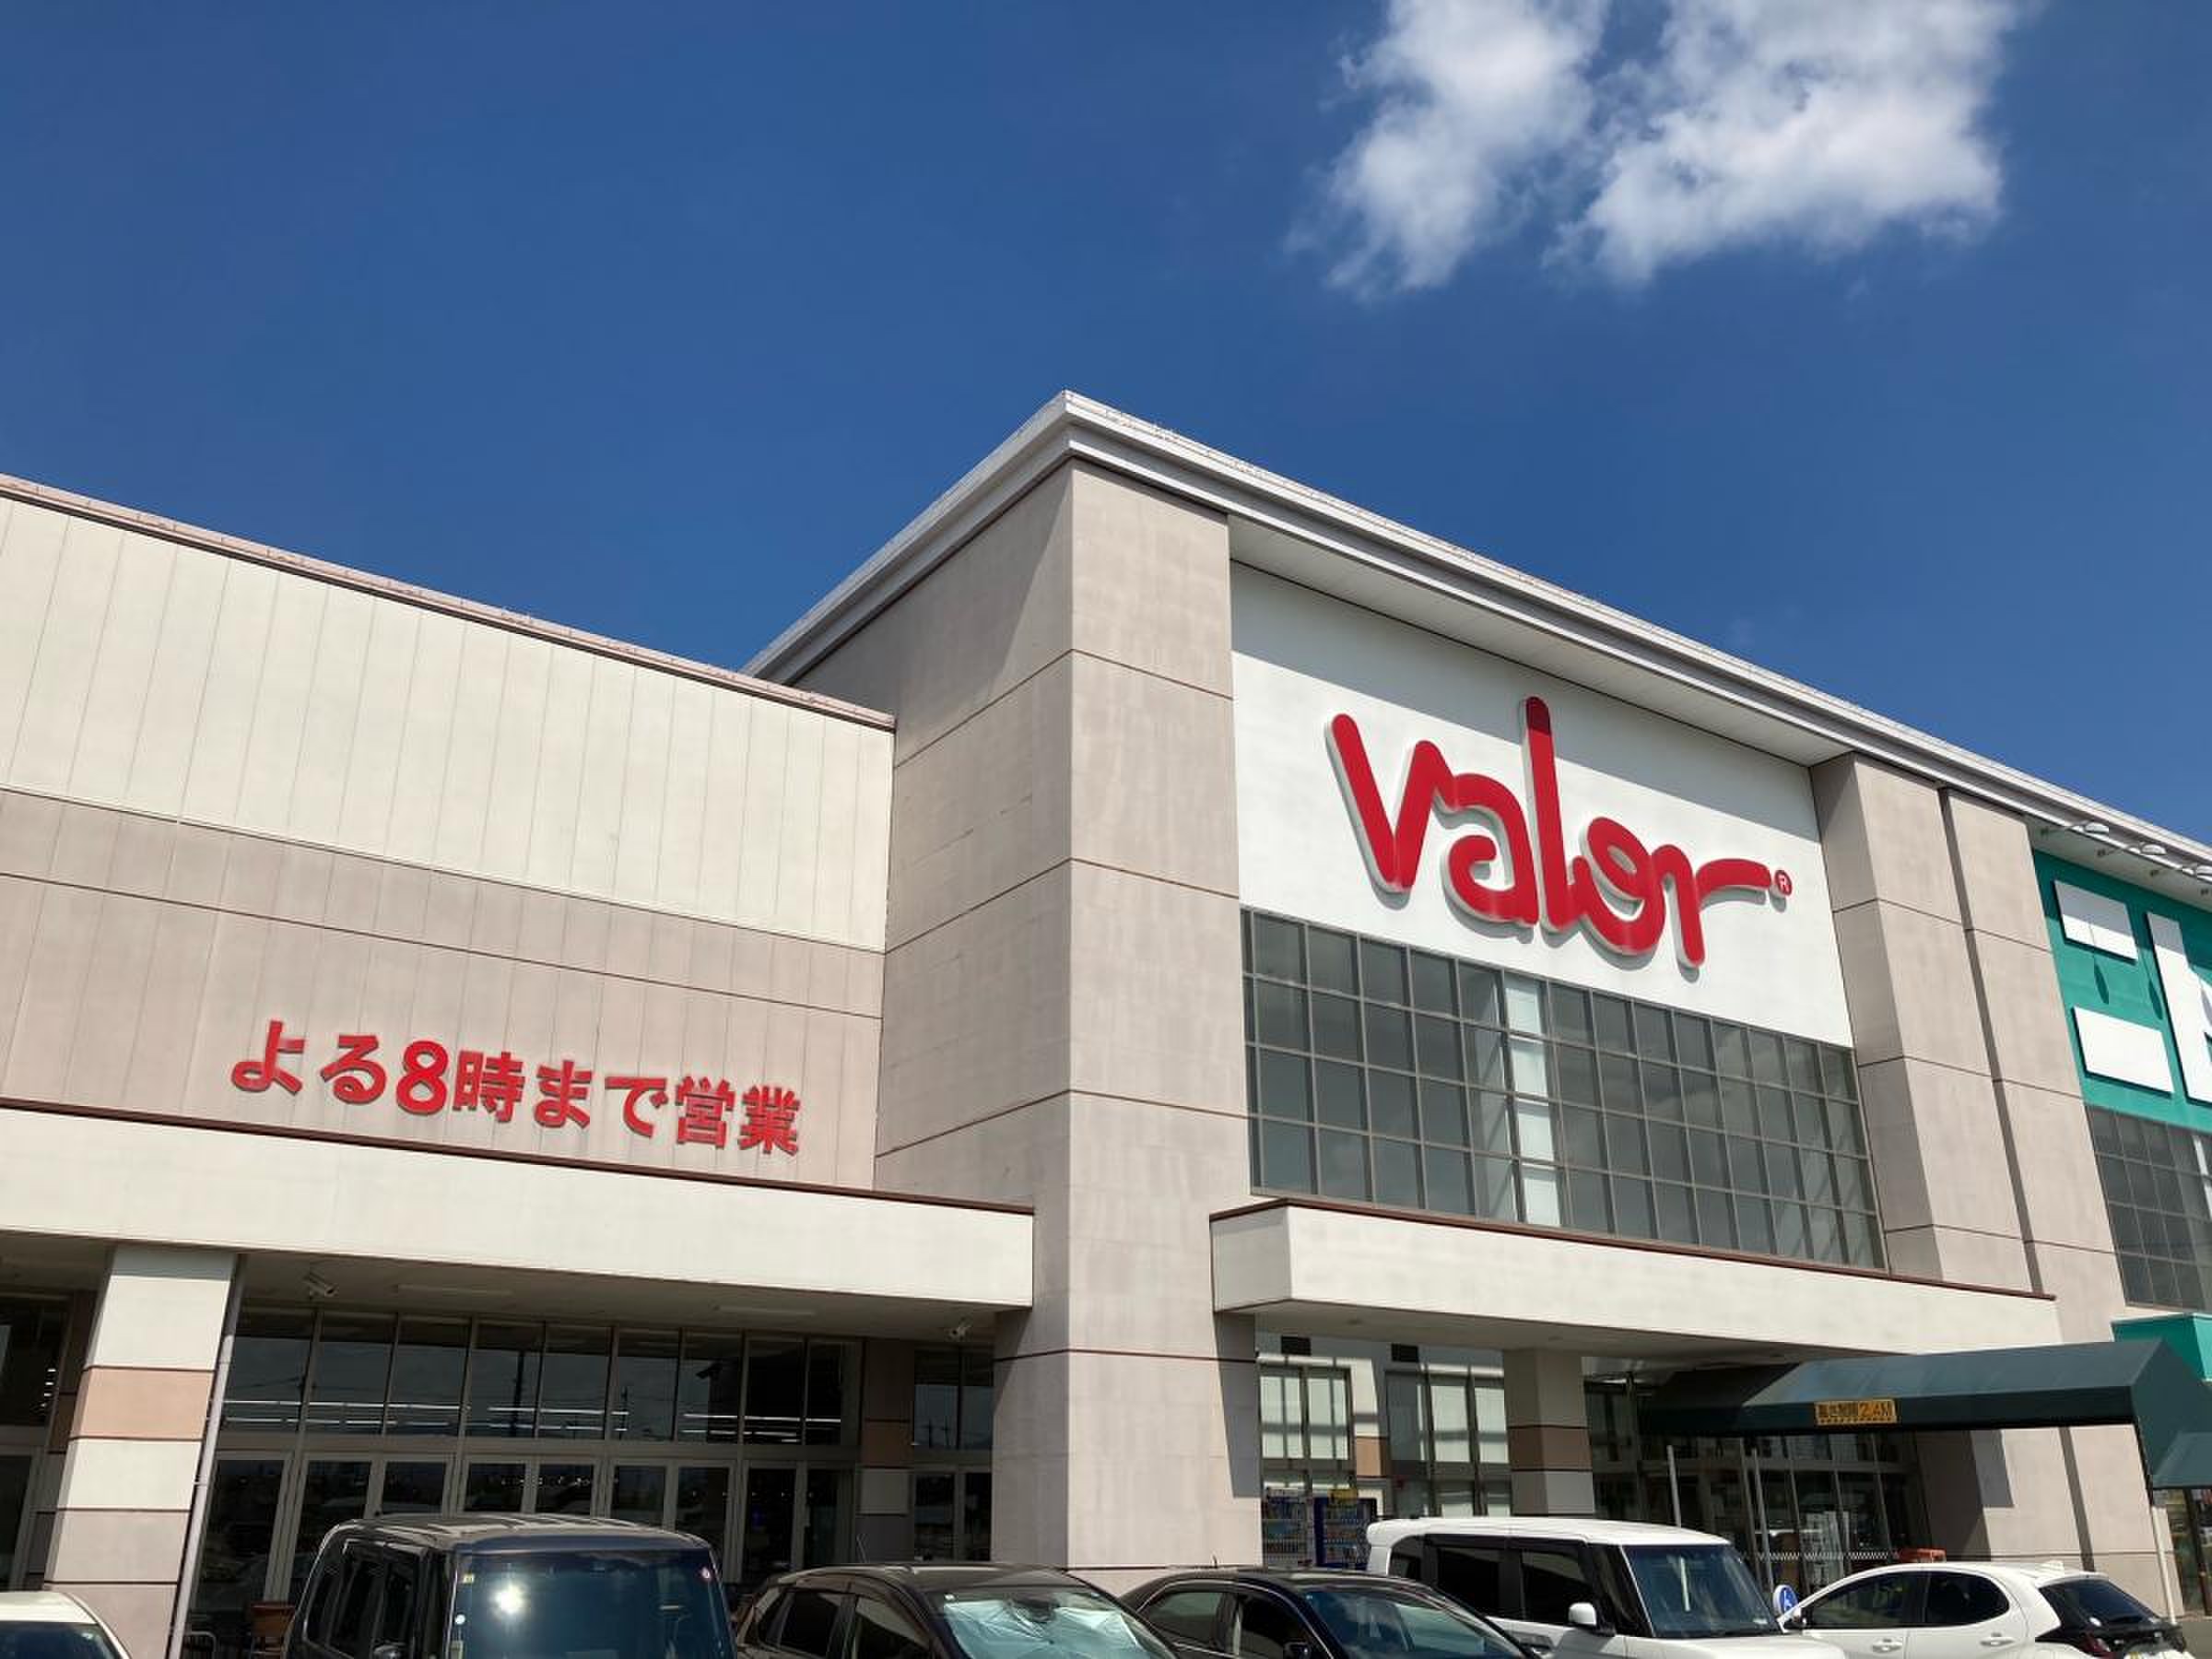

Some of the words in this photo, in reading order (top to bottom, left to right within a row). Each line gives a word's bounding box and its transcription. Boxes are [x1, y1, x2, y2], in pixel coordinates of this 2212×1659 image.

[230, 1020, 799, 1154] よる8時まで営業
